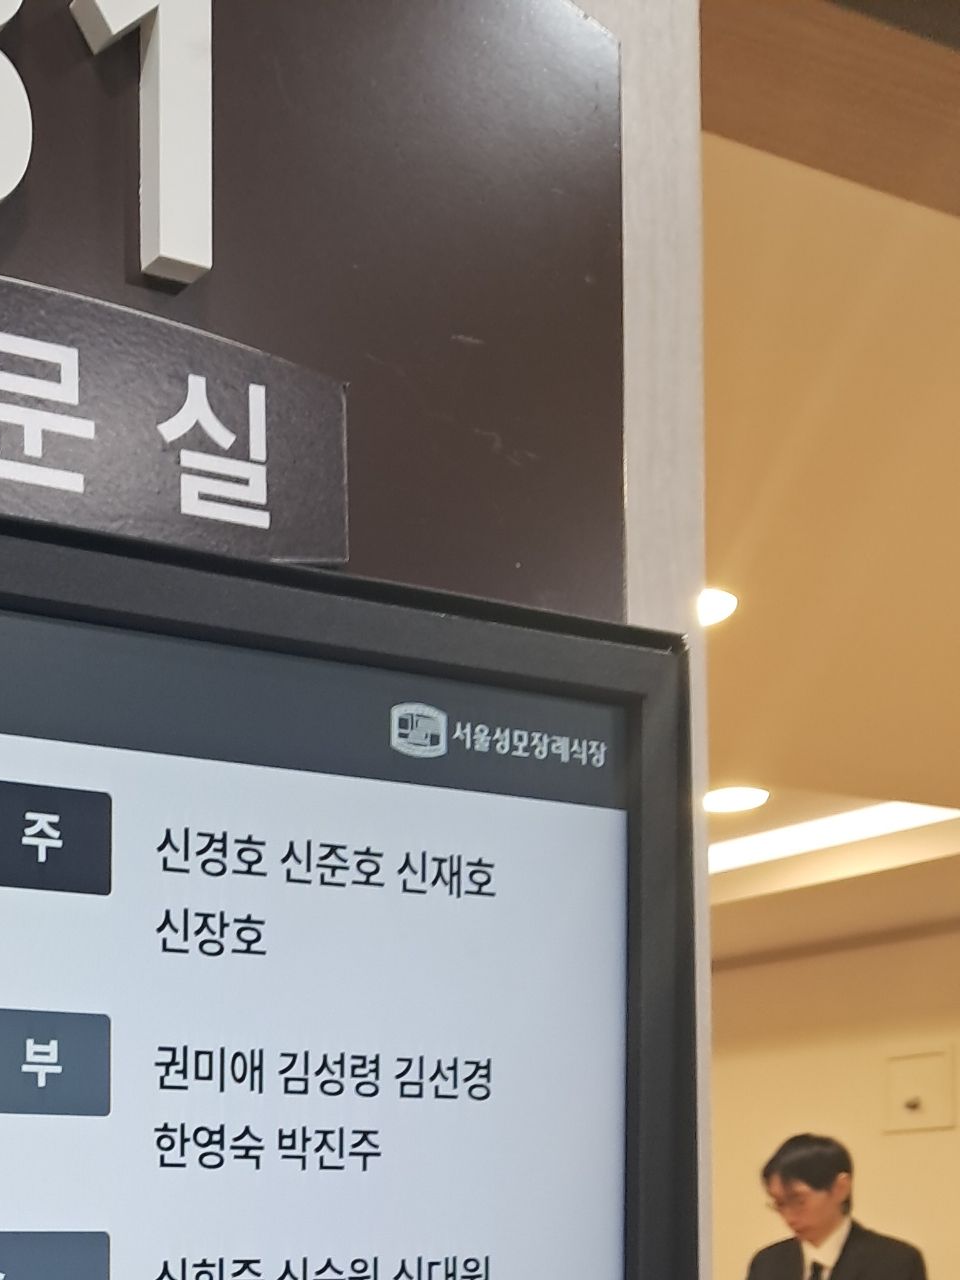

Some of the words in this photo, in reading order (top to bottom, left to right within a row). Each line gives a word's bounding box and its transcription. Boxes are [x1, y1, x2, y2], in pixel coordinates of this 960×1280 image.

[452, 721, 607, 768] 서울성모장례식장
[156, 827, 268, 878] 신경호
[280, 839, 385, 888] 신준호
[396, 850, 496, 899] 신재호
[155, 907, 267, 957] 신장호
[154, 1044, 264, 1095] 권미애
[278, 1050, 380, 1098] 김성령
[394, 1055, 492, 1102] 김선경
[153, 1122, 265, 1171] 한영숙
[277, 1125, 382, 1172] 박진주
